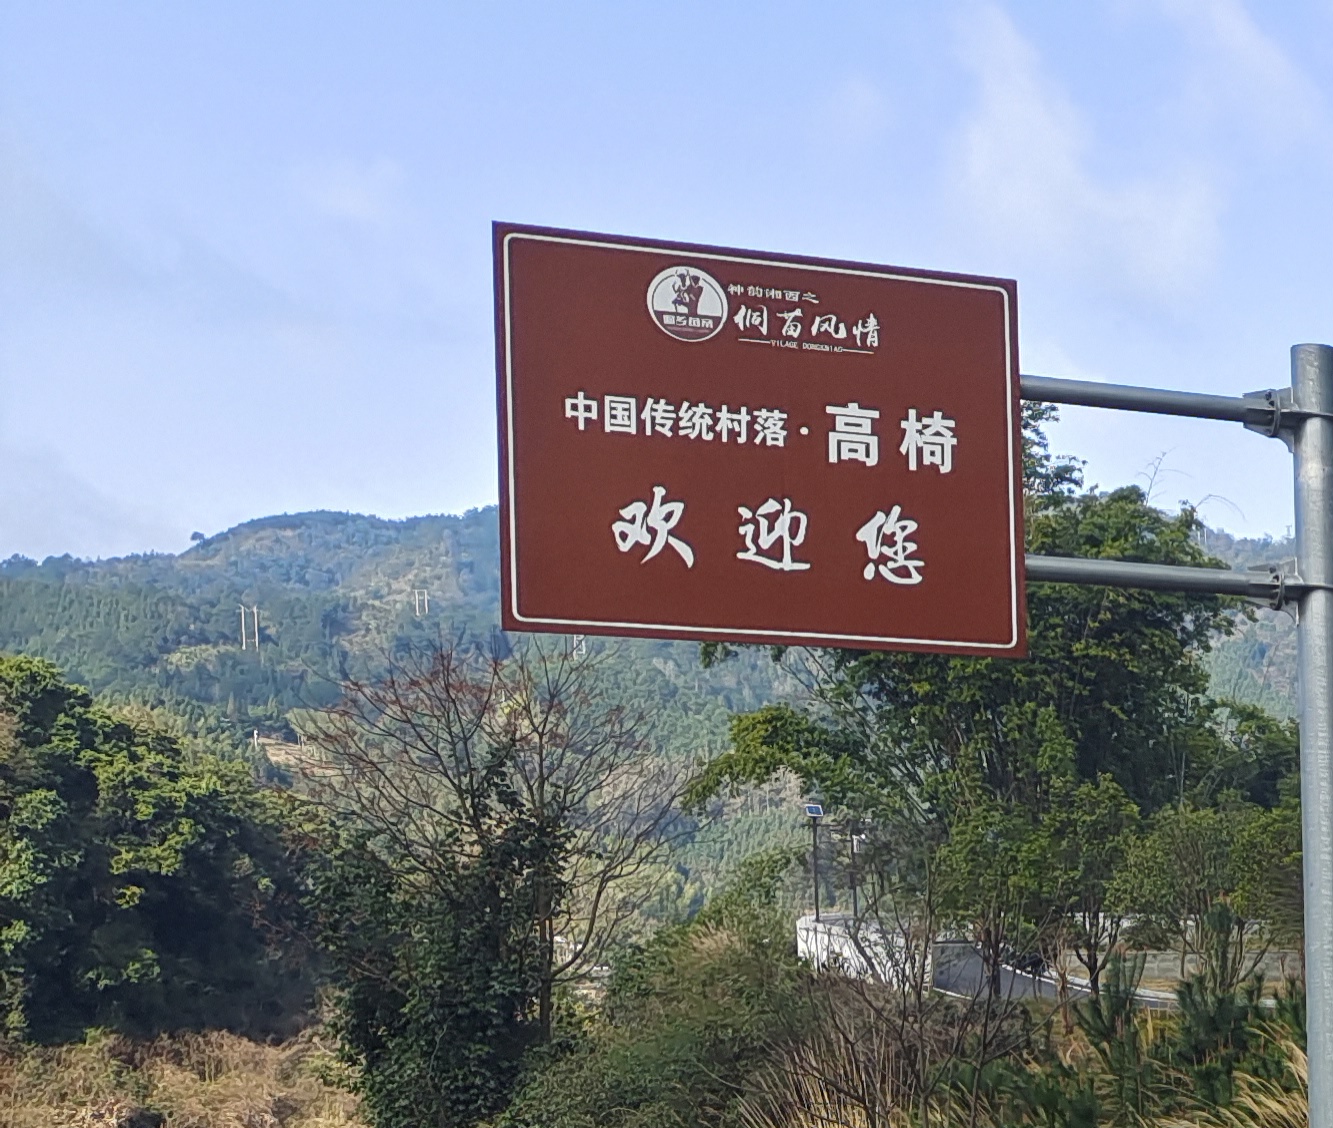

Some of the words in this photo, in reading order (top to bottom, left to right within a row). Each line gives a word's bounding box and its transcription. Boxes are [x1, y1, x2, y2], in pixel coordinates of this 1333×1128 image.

[733, 304, 881, 347] 侗苗风情
[611, 486, 925, 586] 欢迎您
